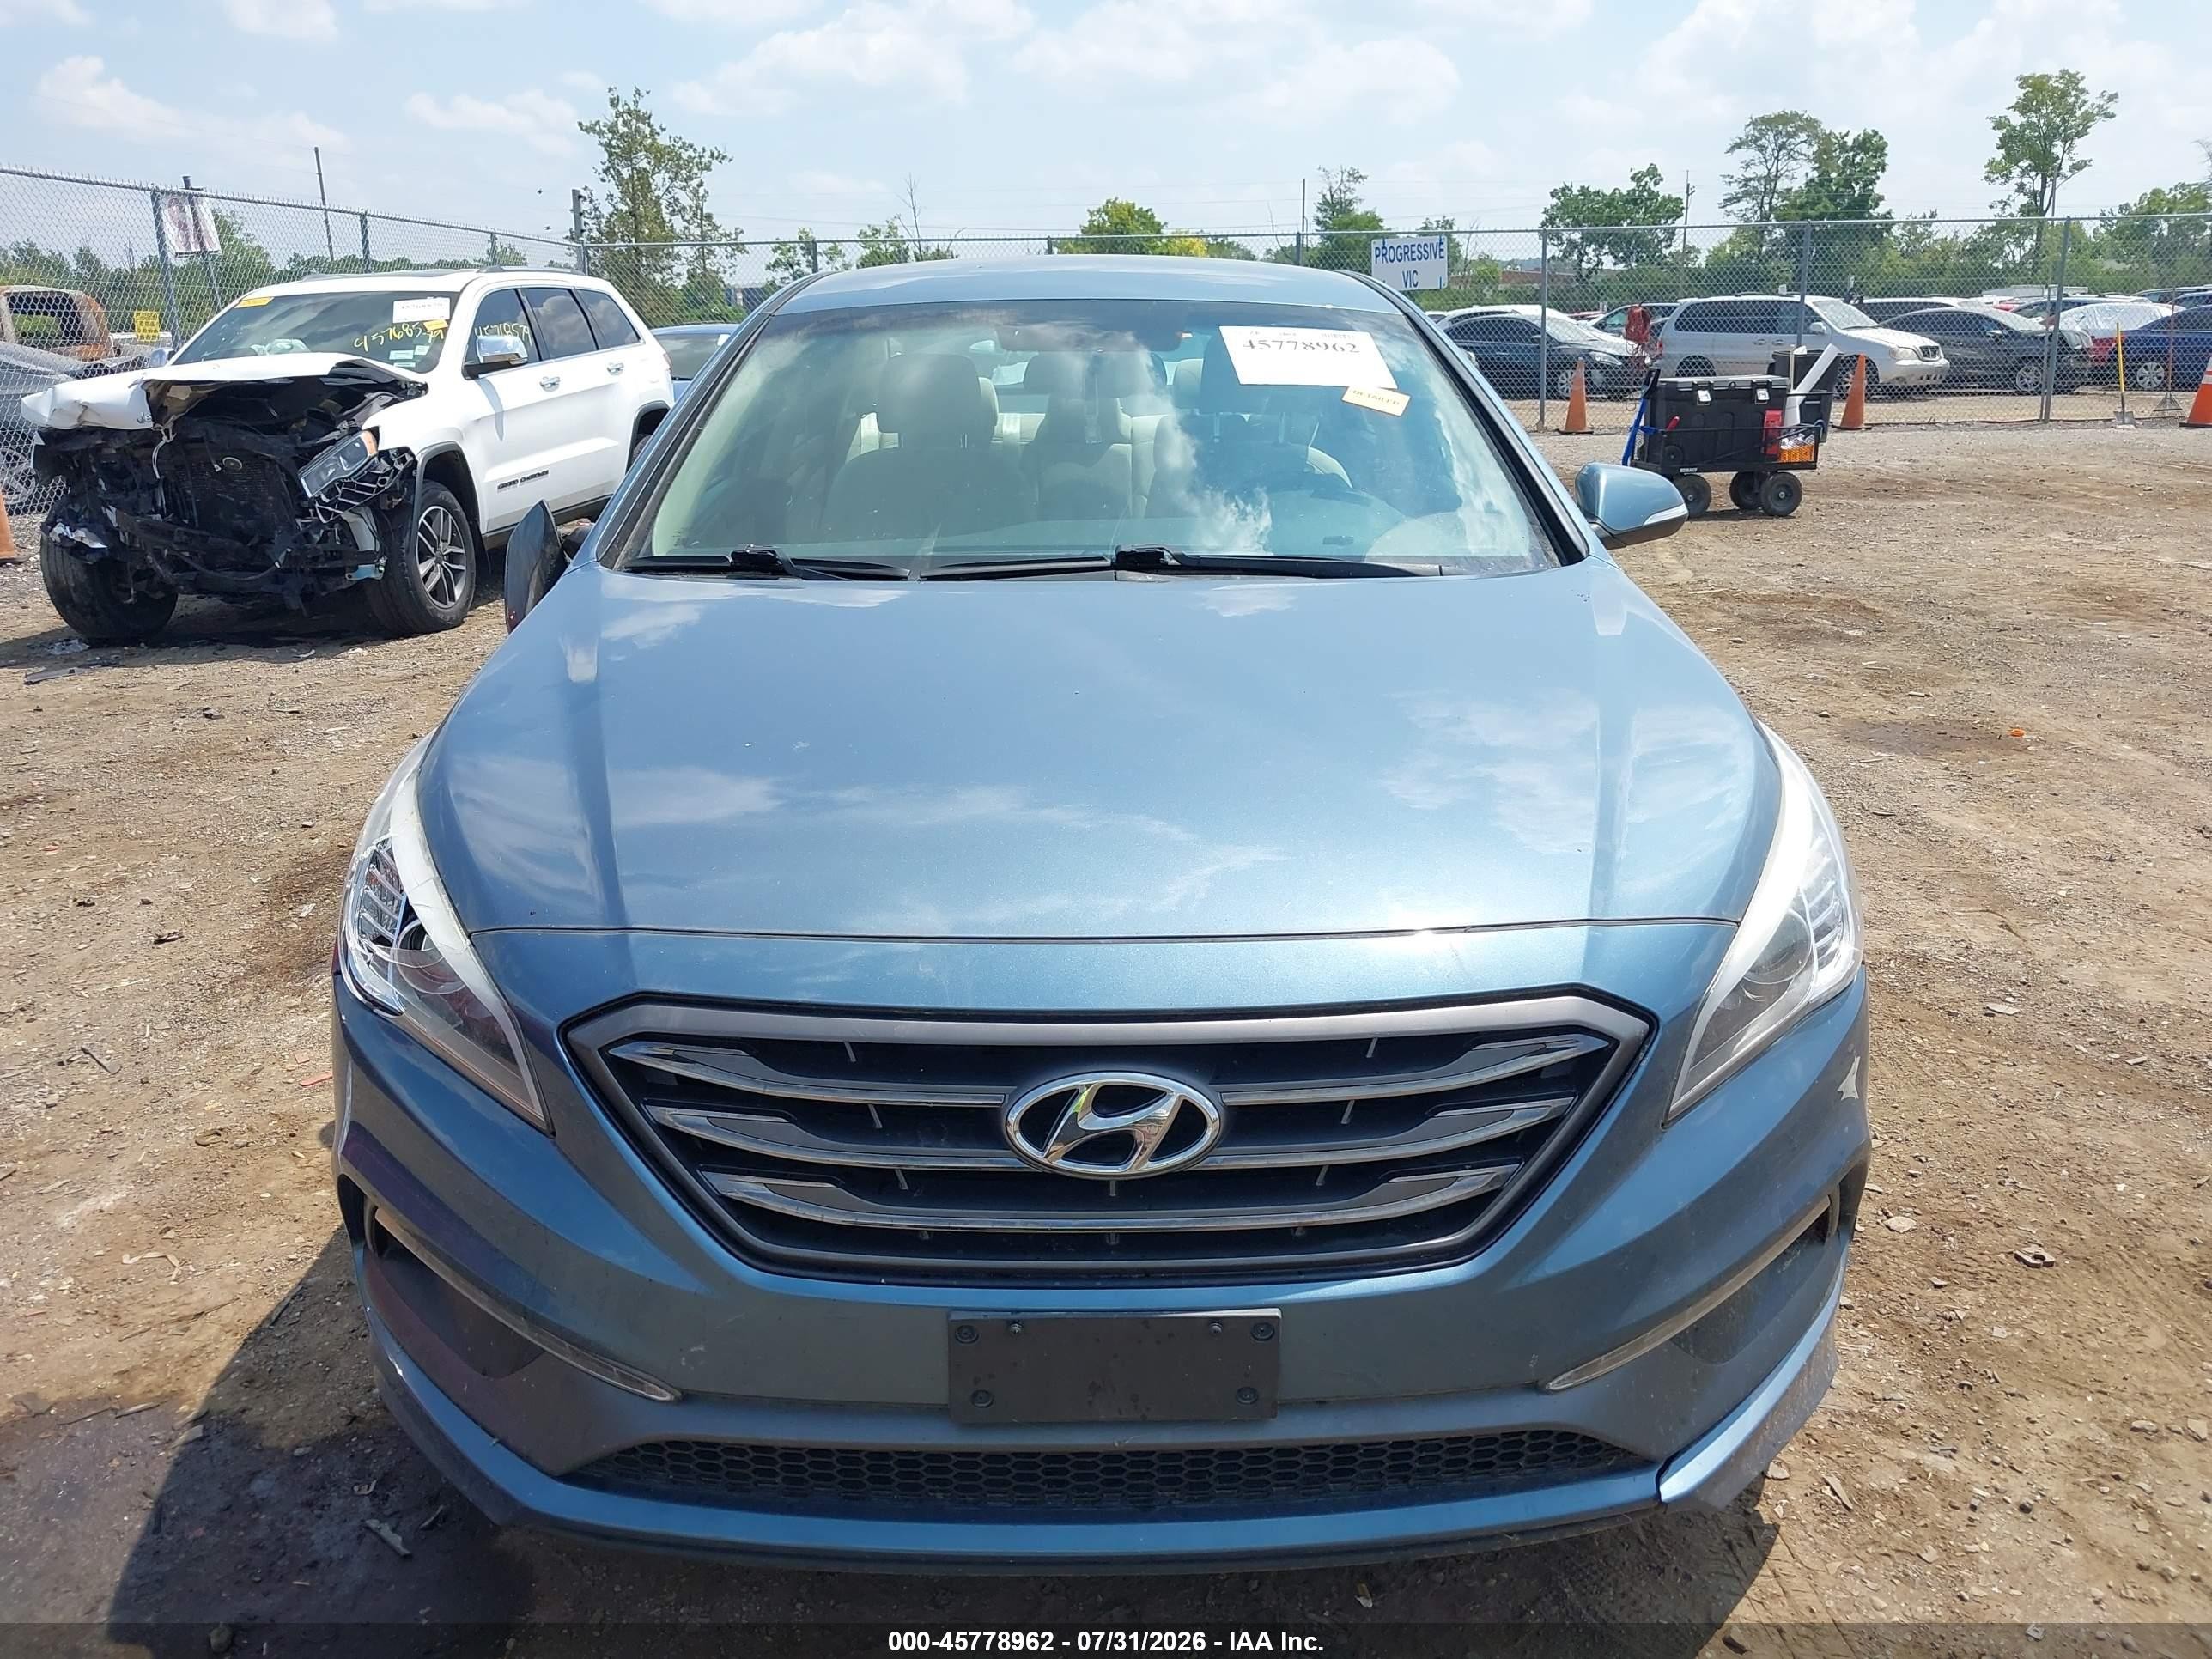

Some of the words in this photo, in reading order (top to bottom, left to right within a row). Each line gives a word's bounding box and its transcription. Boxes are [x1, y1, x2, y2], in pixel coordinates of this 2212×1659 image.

[1375, 241, 1444, 264] PROGRESSIVE
[1402, 270, 1419, 288] VIC
[1243, 338, 1361, 354] 45778962
